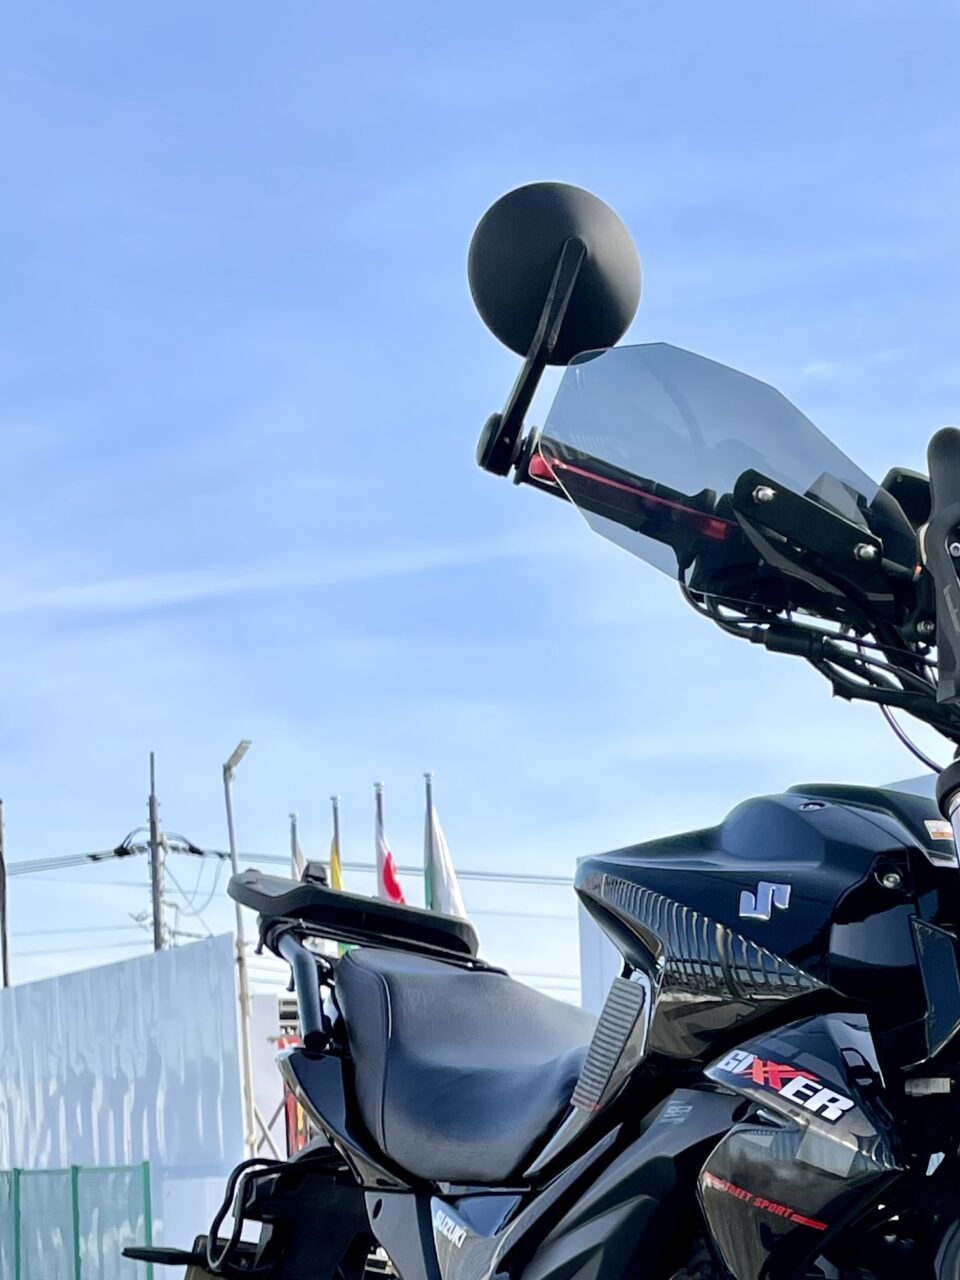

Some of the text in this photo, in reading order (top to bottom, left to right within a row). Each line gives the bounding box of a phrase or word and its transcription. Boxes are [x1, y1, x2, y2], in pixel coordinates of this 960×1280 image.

[717, 1049, 855, 1121] GIXXER
[753, 1197, 794, 1218] SPORT
[434, 1209, 467, 1249] SUZUKI
